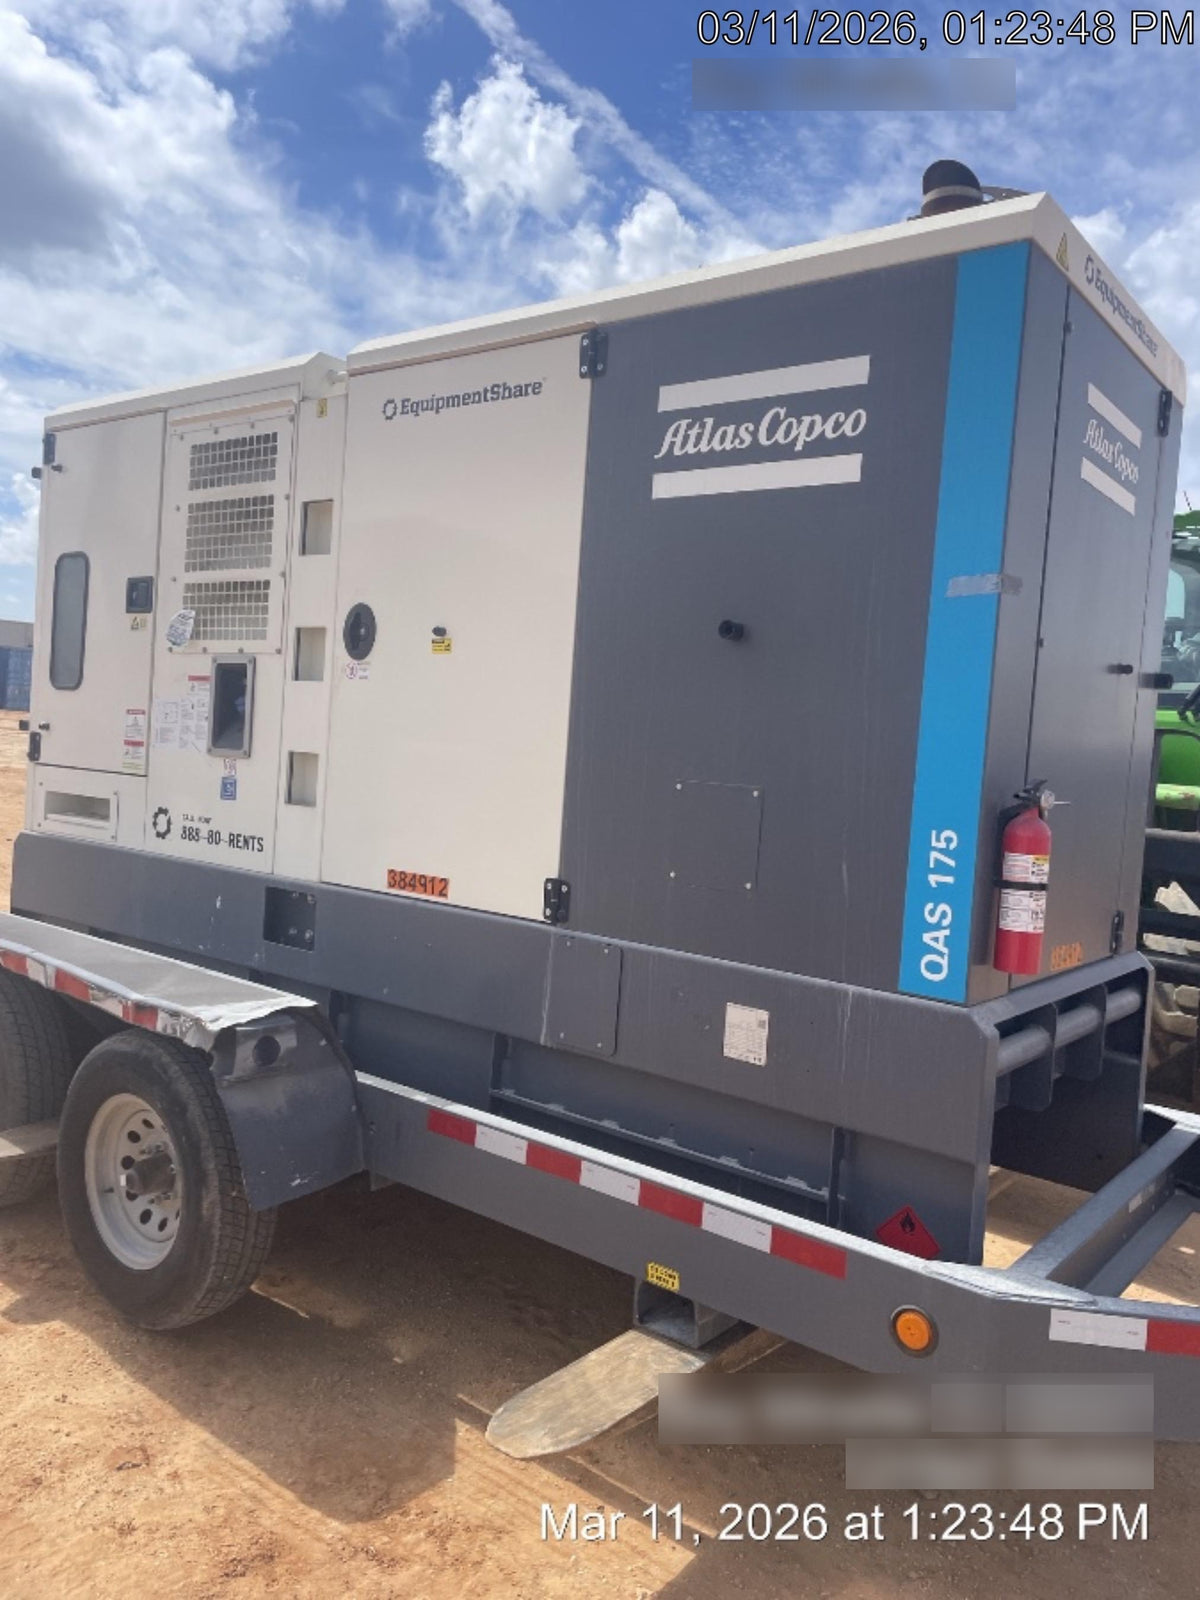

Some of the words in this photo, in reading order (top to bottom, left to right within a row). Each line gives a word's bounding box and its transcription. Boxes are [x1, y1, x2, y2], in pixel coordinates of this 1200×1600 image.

[400, 380, 543, 416] EquipmentShare
[654, 417, 754, 459] Atlas
[758, 406, 867, 452] Copco
[1082, 419, 1113, 463] Atlas
[927, 829, 958, 888] 175
[387, 868, 448, 898] 384912
[920, 902, 953, 982] QAS
